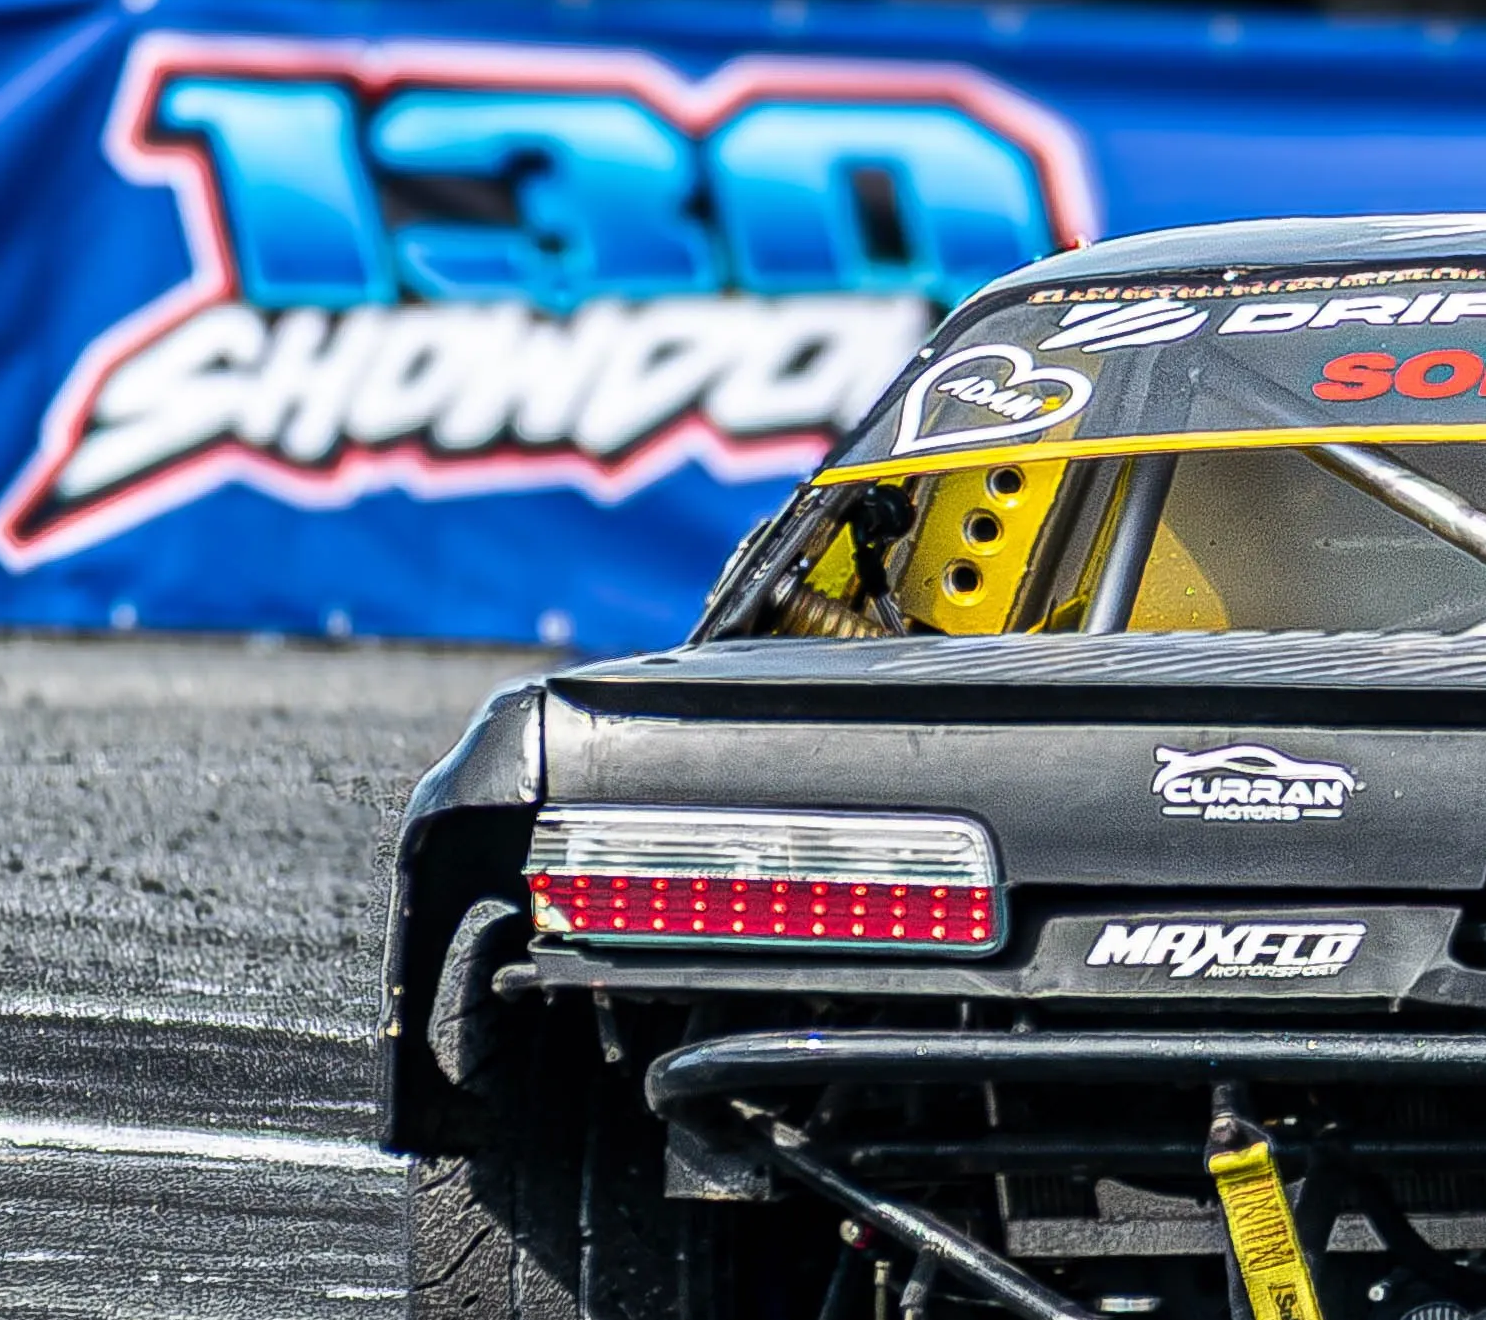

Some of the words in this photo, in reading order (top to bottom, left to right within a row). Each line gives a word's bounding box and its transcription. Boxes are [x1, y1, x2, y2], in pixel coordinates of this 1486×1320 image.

[159, 75, 1056, 307] 130
[59, 294, 924, 501] SHOWDO
[1163, 778, 1344, 807] CURRAN
[1203, 805, 1301, 822] MOTORS
[1087, 923, 1368, 978] MAXFLO
[1203, 963, 1347, 979] MOTORSPORT
